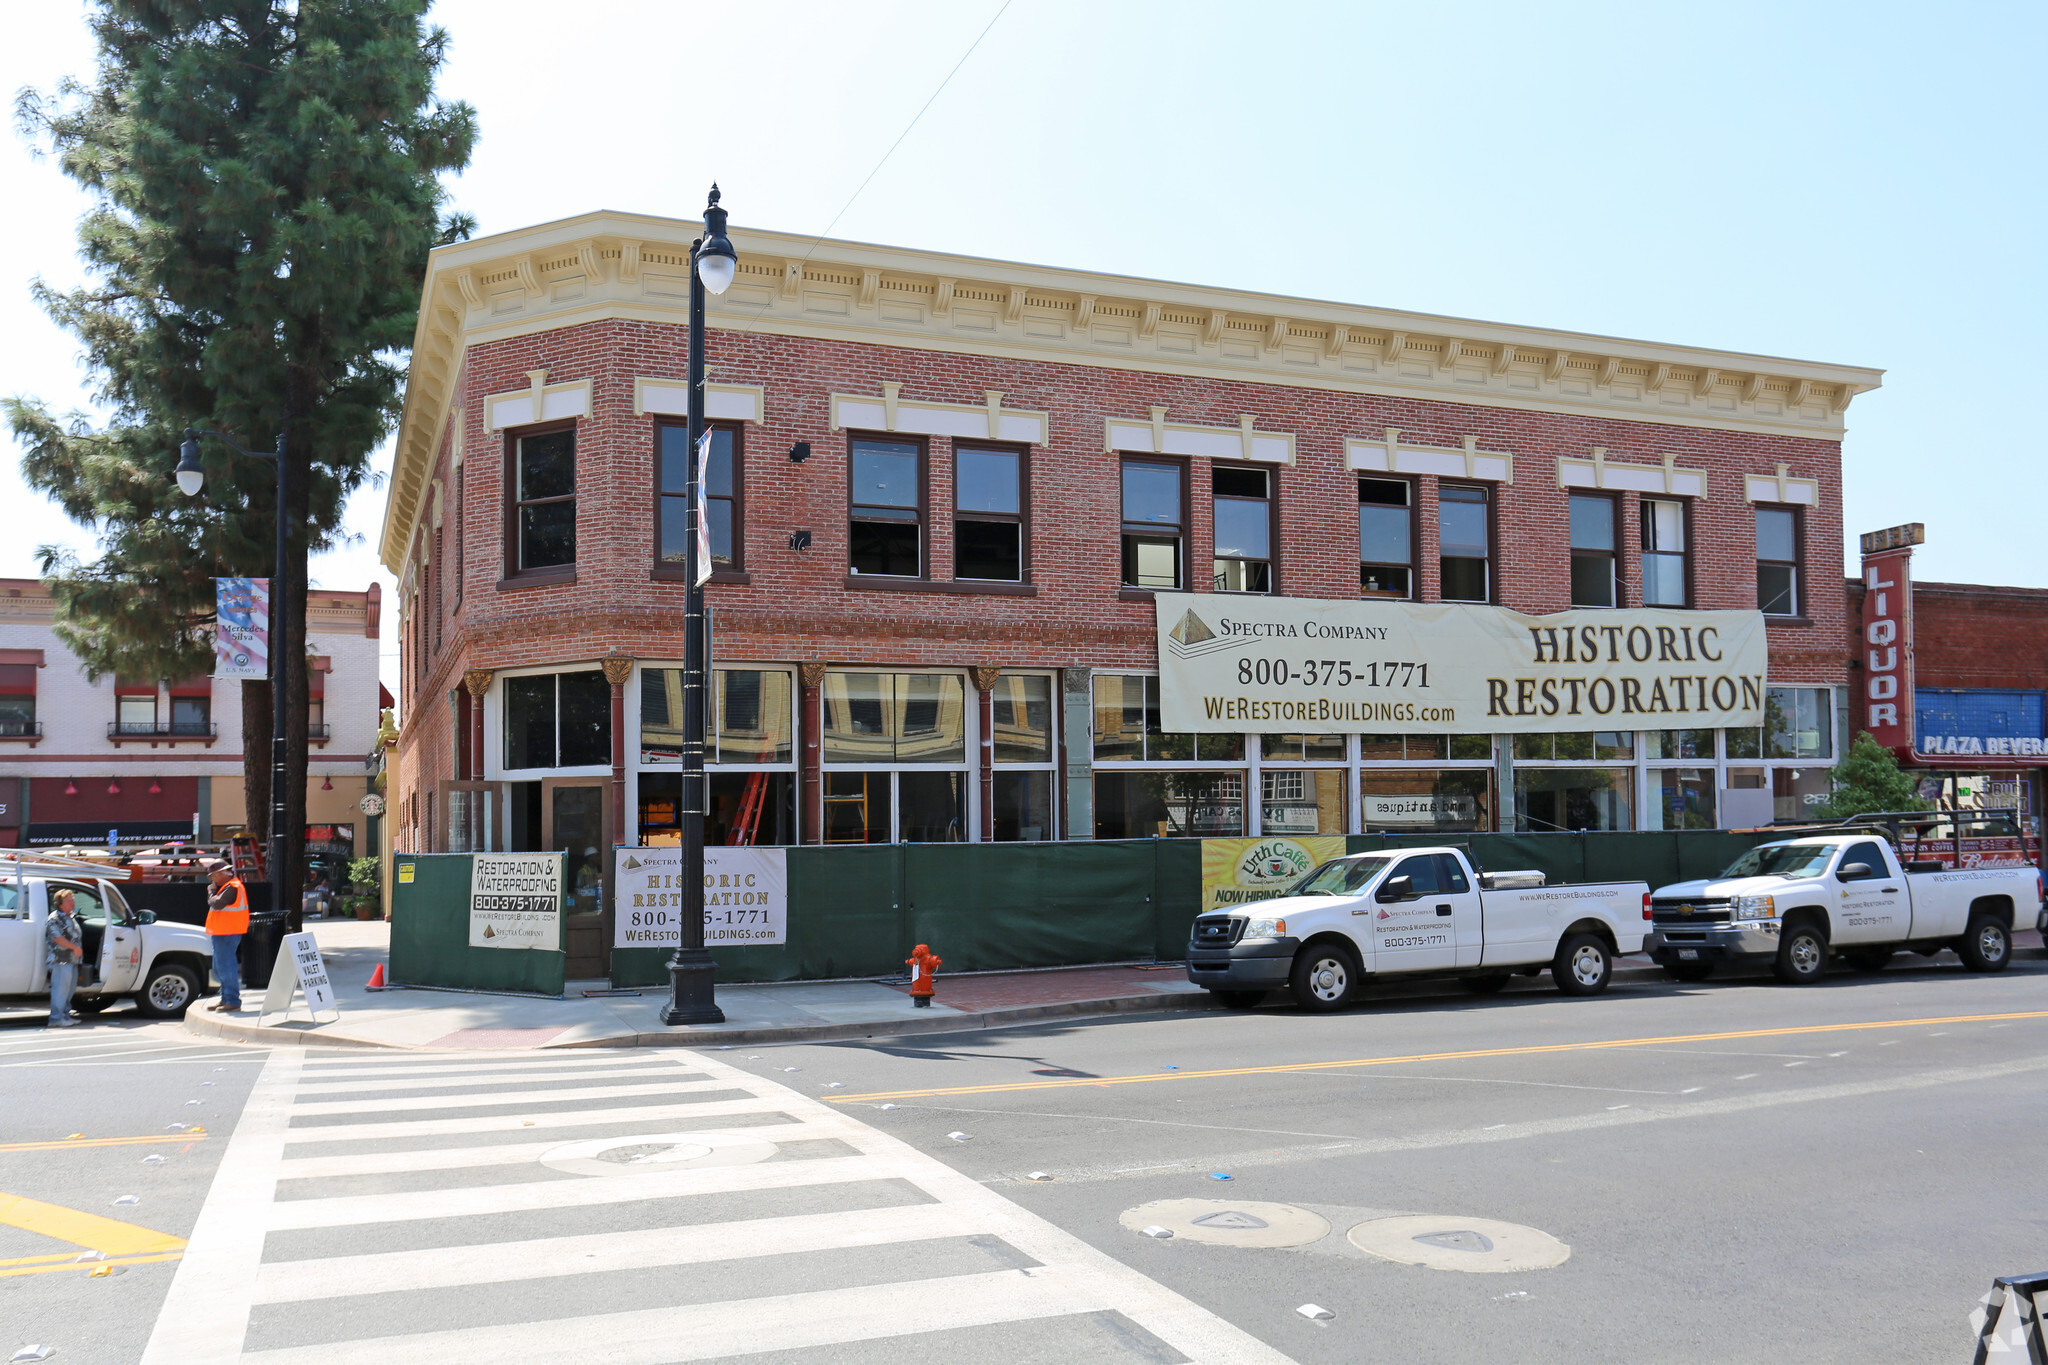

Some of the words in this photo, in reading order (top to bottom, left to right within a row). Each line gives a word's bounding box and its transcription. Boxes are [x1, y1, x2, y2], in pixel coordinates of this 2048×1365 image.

[222, 591, 263, 603] Orange
[221, 624, 265, 633] Mercedes
[1220, 618, 1298, 638] SPECTRA
[1303, 621, 1389, 640] COMPANY
[231, 633, 253, 641] Silva
[1528, 624, 1723, 664] HISTORIC
[1866, 566, 1898, 727] LIQUOR
[1237, 657, 1431, 688] 800-375-1771
[1486, 674, 1763, 717] RESTORATION
[1923, 735, 1984, 755] PLAZA
[643, 858, 677, 866] SPECTRA
[1241, 846, 1272, 874] Urth
[1272, 843, 1310, 872] Caffé
[477, 859, 544, 875] RESTORATION
[545, 859, 554, 875] &
[477, 875, 557, 892] WATERPROOFING
[648, 874, 756, 889] HISORIC
[475, 896, 555, 911] 800-375-1771
[633, 892, 769, 907] RESTATION
[1215, 889, 1244, 903] NOW
[1245, 889, 1282, 903] HIRING
[631, 910, 770, 926] 800-5-1771
[1848, 916, 1893, 926] 800-375-1771
[496, 928, 517, 936] SPECTRA
[518, 928, 545, 937] COMPANY
[1376, 925, 1409, 933] RESTORATION
[1414, 922, 1452, 930] WATERPROOFING
[625, 929, 776, 942] WERESTOILDINGS.com
[1384, 935, 1446, 948] 800-375-1771
[297, 940, 310, 951] OLD
[297, 951, 318, 964] TOWNE
[302, 963, 320, 976] VALET
[303, 974, 328, 989] PARKING
